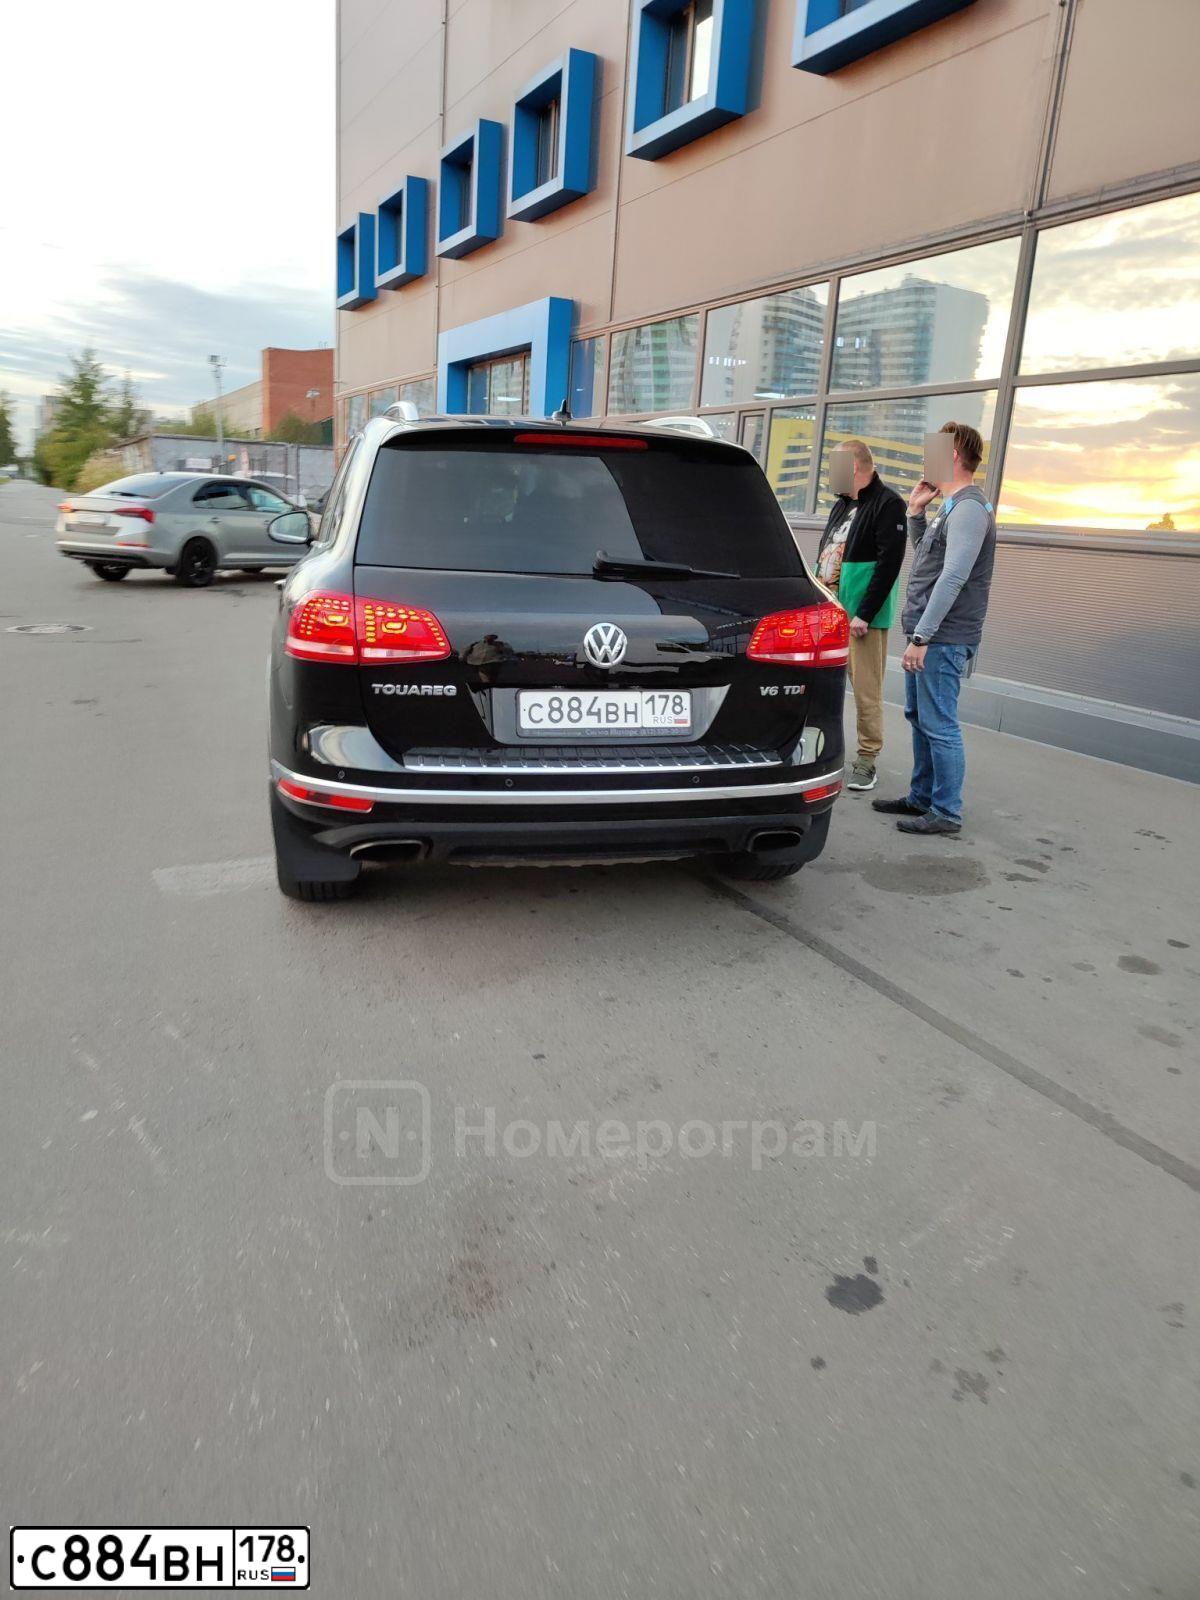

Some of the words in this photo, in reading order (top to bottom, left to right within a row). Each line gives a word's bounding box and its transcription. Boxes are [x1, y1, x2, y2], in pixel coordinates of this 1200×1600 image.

[371, 683, 457, 696] TOUAREG
[759, 686, 779, 696] V6
[783, 684, 806, 695] TDI
[528, 696, 638, 724] С884ВН
[645, 694, 683, 715] 178
[652, 716, 673, 724] RUS
